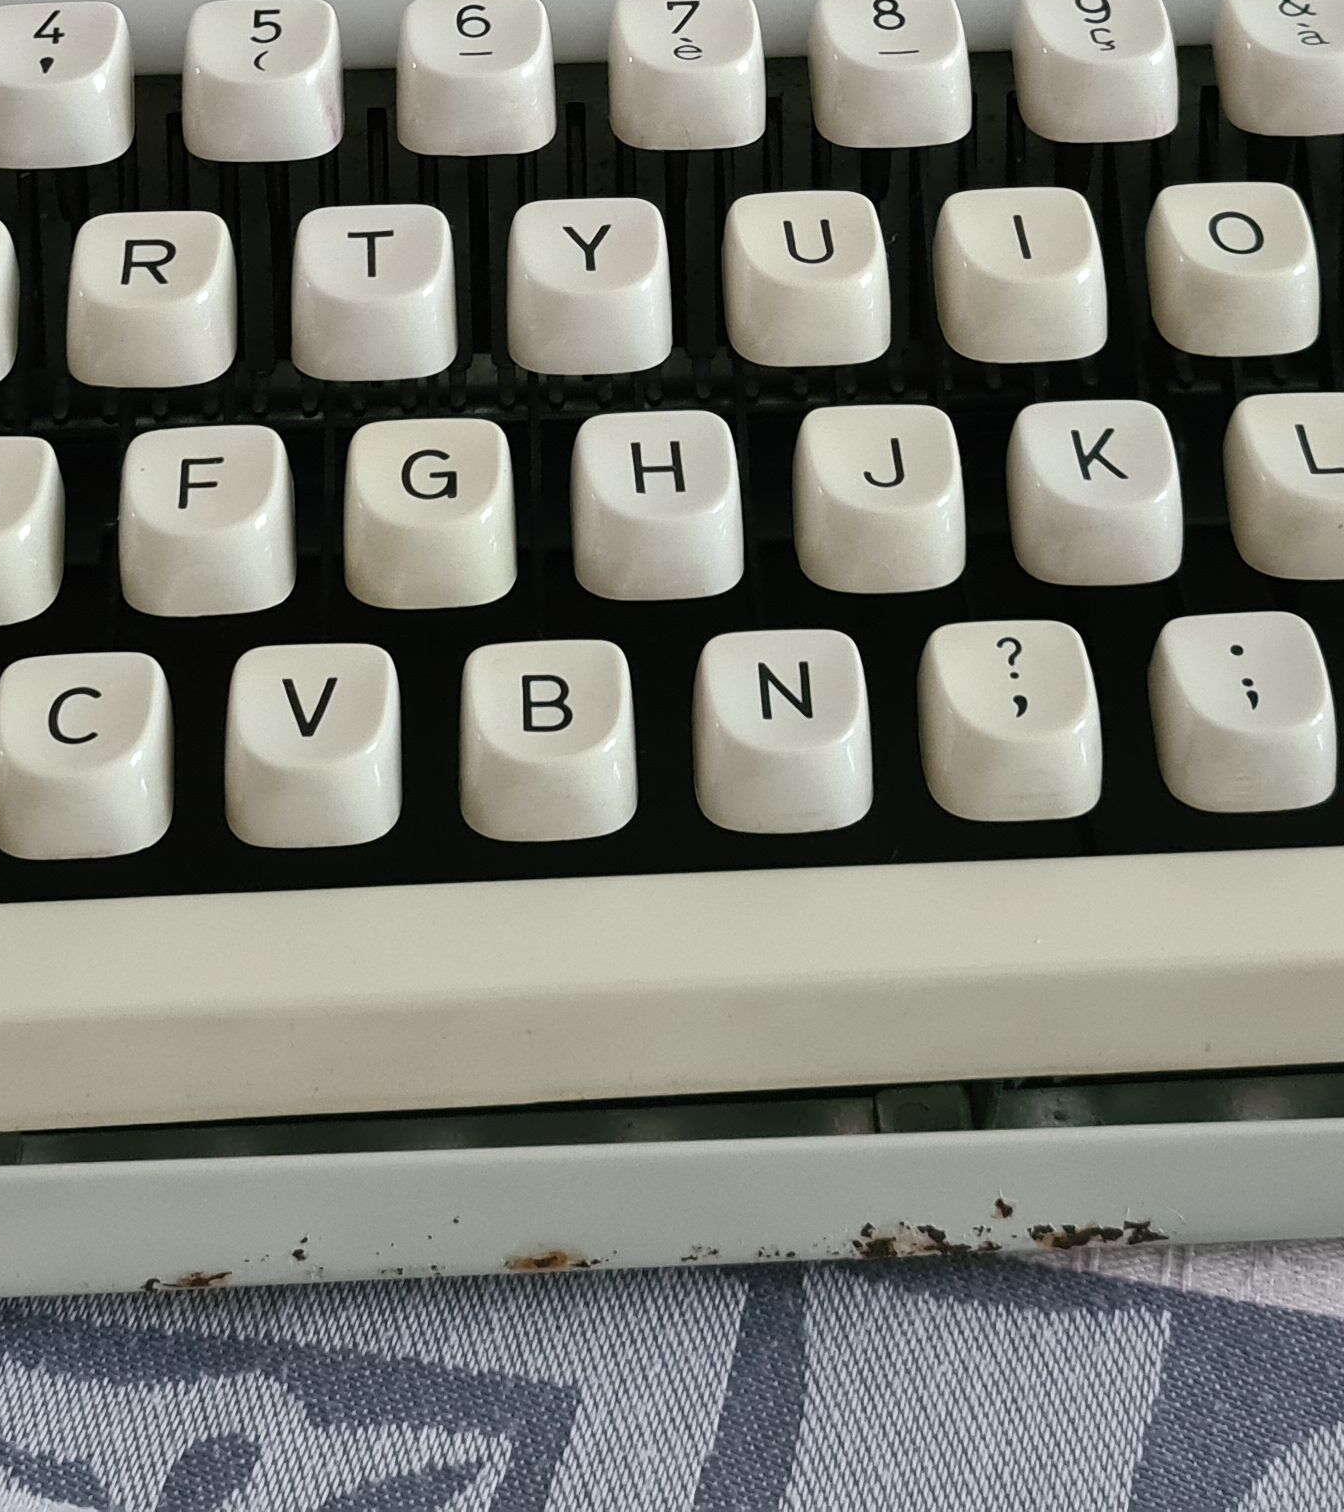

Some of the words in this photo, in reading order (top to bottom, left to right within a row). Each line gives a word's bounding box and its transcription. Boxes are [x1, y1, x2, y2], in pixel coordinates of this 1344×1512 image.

[32, 9, 66, 45] 4
[249, 8, 283, 45] 5
[455, 4, 492, 39] 6
[666, 0, 701, 35] 7
[346, 229, 395, 278] T
[561, 223, 612, 272] Y
[782, 218, 835, 265] U
[1012, 214, 1033, 260] I
[1208, 210, 1265, 255] O
[120, 238, 177, 286] R
[400, 448, 458, 501] G
[630, 440, 687, 495] H
[863, 437, 906, 489] J
[1070, 427, 1130, 481] K
[177, 456, 225, 510] F
[996, 636, 1023, 680] ?
[281, 676, 339, 738] V
[521, 674, 574, 733] B
[757, 660, 814, 721] N
[47, 686, 103, 745] C
